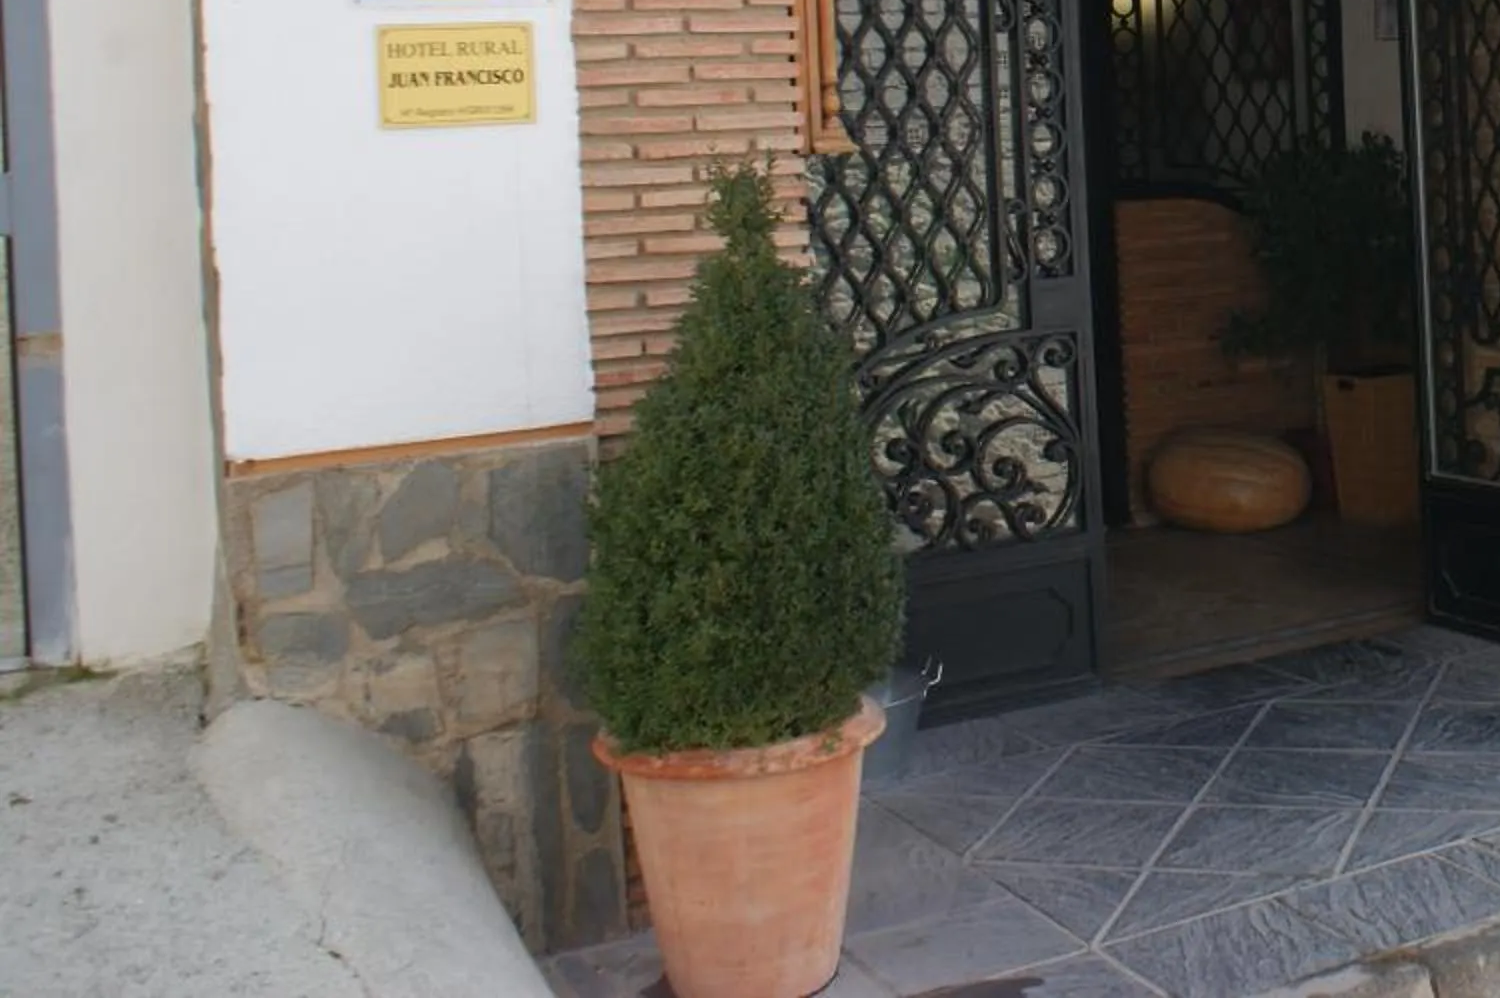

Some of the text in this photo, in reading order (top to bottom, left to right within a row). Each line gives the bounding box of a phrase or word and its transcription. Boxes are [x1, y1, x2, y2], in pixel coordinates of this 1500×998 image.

[387, 39, 523, 59] HOTEL RURAL
[388, 68, 525, 89] JUAN FRANCISCO
